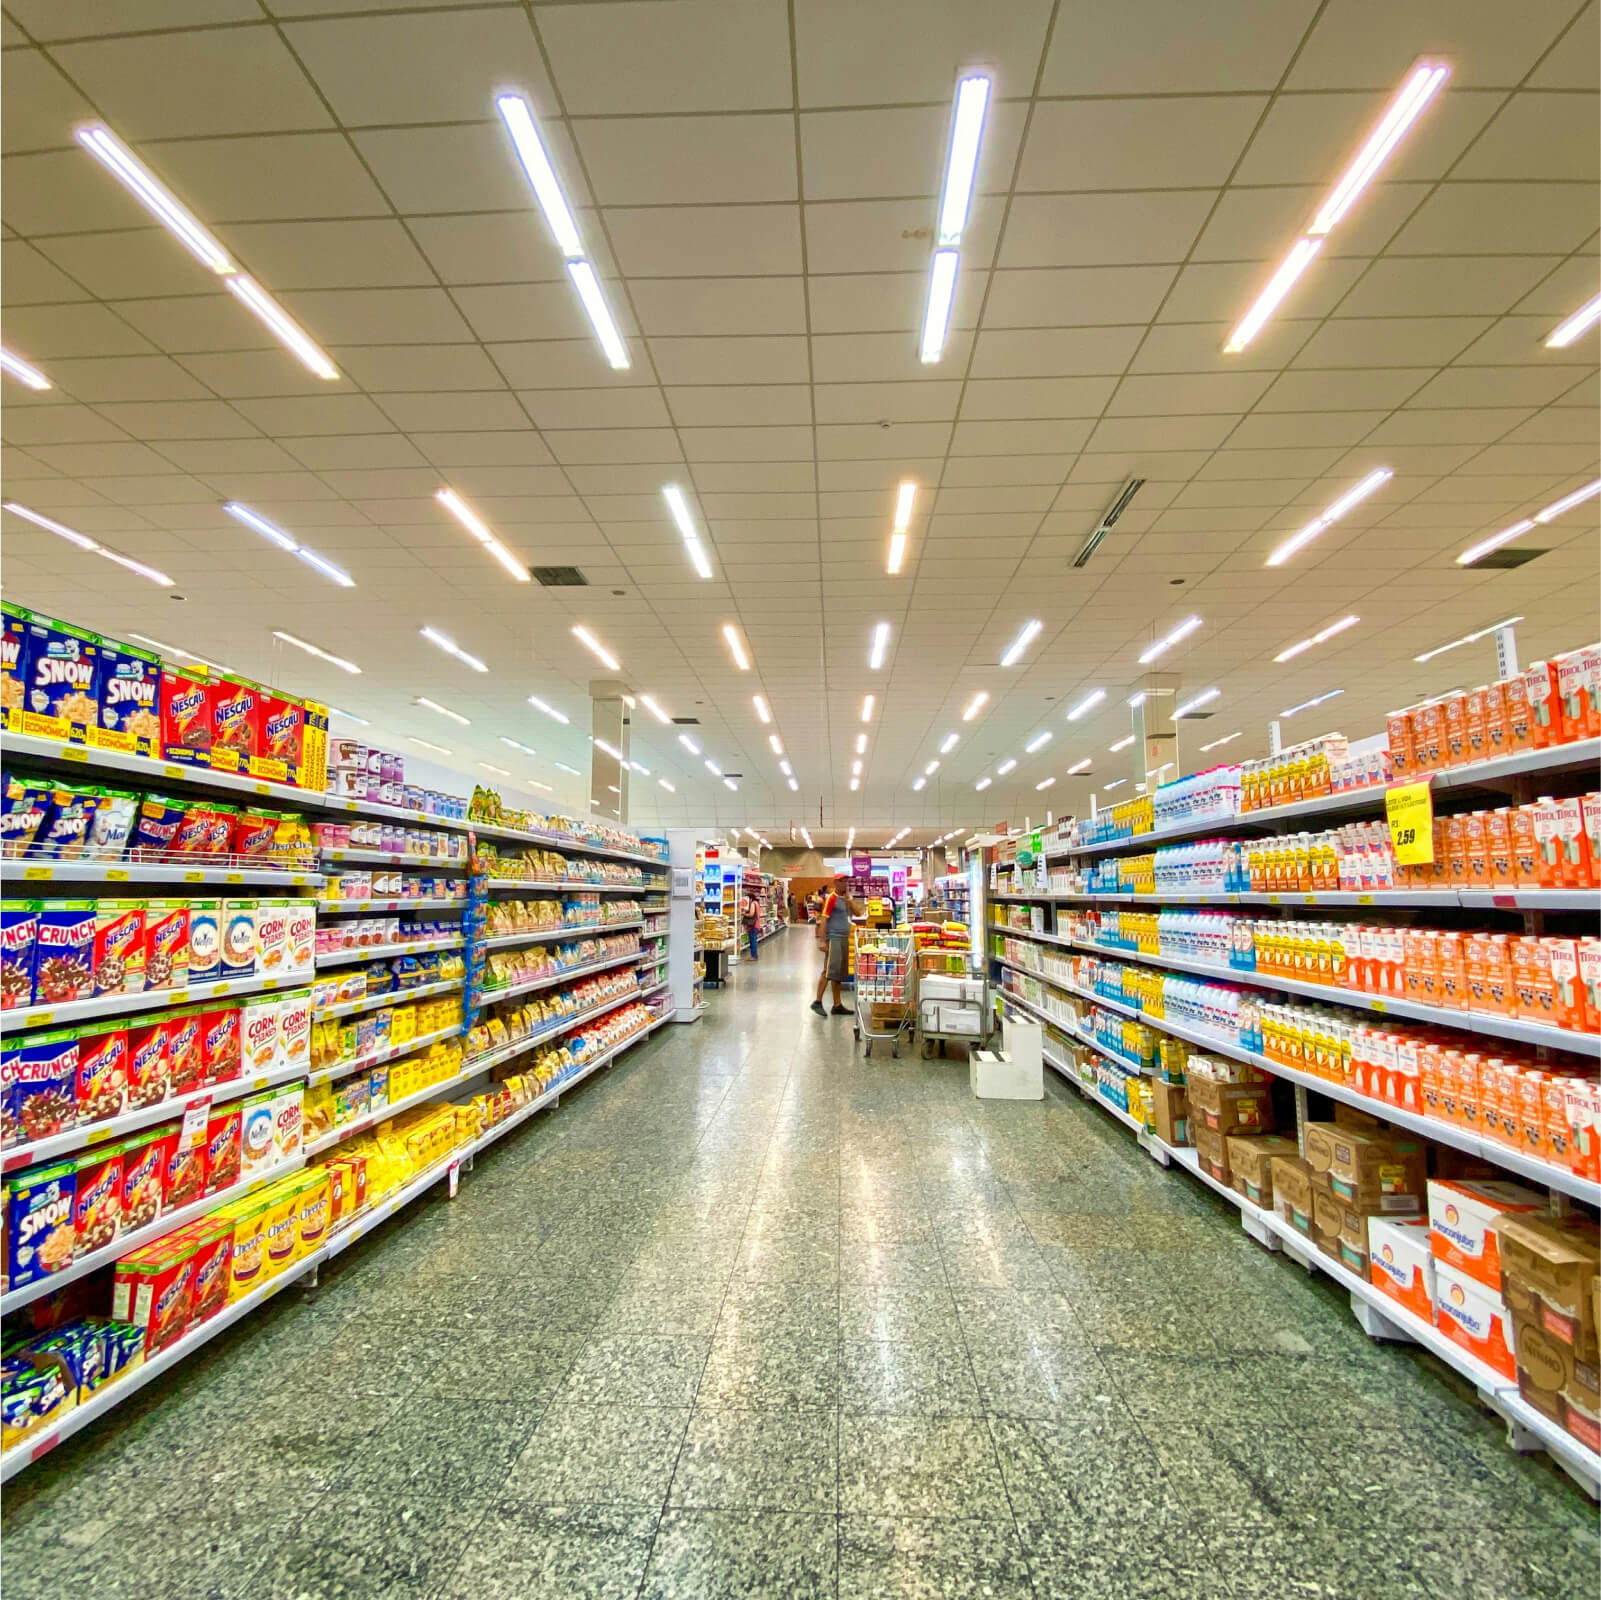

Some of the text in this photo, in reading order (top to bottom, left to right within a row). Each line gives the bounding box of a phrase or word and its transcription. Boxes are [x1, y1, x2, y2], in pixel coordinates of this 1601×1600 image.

[35, 657, 94, 686] SNOW
[106, 678, 155, 704] SNOW
[170, 691, 204, 717] NESCAU
[214, 696, 253, 724] NESCAU
[24, 721, 68, 738] ECONÔMICA
[266, 711, 299, 738] NESCAU
[1, 810, 45, 832] SNOW
[38, 919, 96, 945] CRUNCH
[106, 918, 140, 948] NESCAU
[155, 916, 185, 944] NESCAU
[259, 919, 284, 938] CORN
[290, 919, 312, 937] CORN
[206, 1016, 237, 1050] NESCAU
[249, 1014, 274, 1039] CORN
[282, 1008, 306, 1032] CORN
[18, 1048, 79, 1082] CRUNCH
[81, 1040, 124, 1085] NESCAU
[133, 1031, 170, 1074] NESCAU
[277, 1104, 300, 1128] CORN
[208, 1118, 240, 1160] NESCAU
[124, 1150, 160, 1198] NESCAU
[78, 1165, 121, 1218] NESCAU
[18, 1195, 72, 1245] SNOW
[196, 1240, 230, 1292] NESCAU
[156, 1261, 194, 1319] NESCAU
